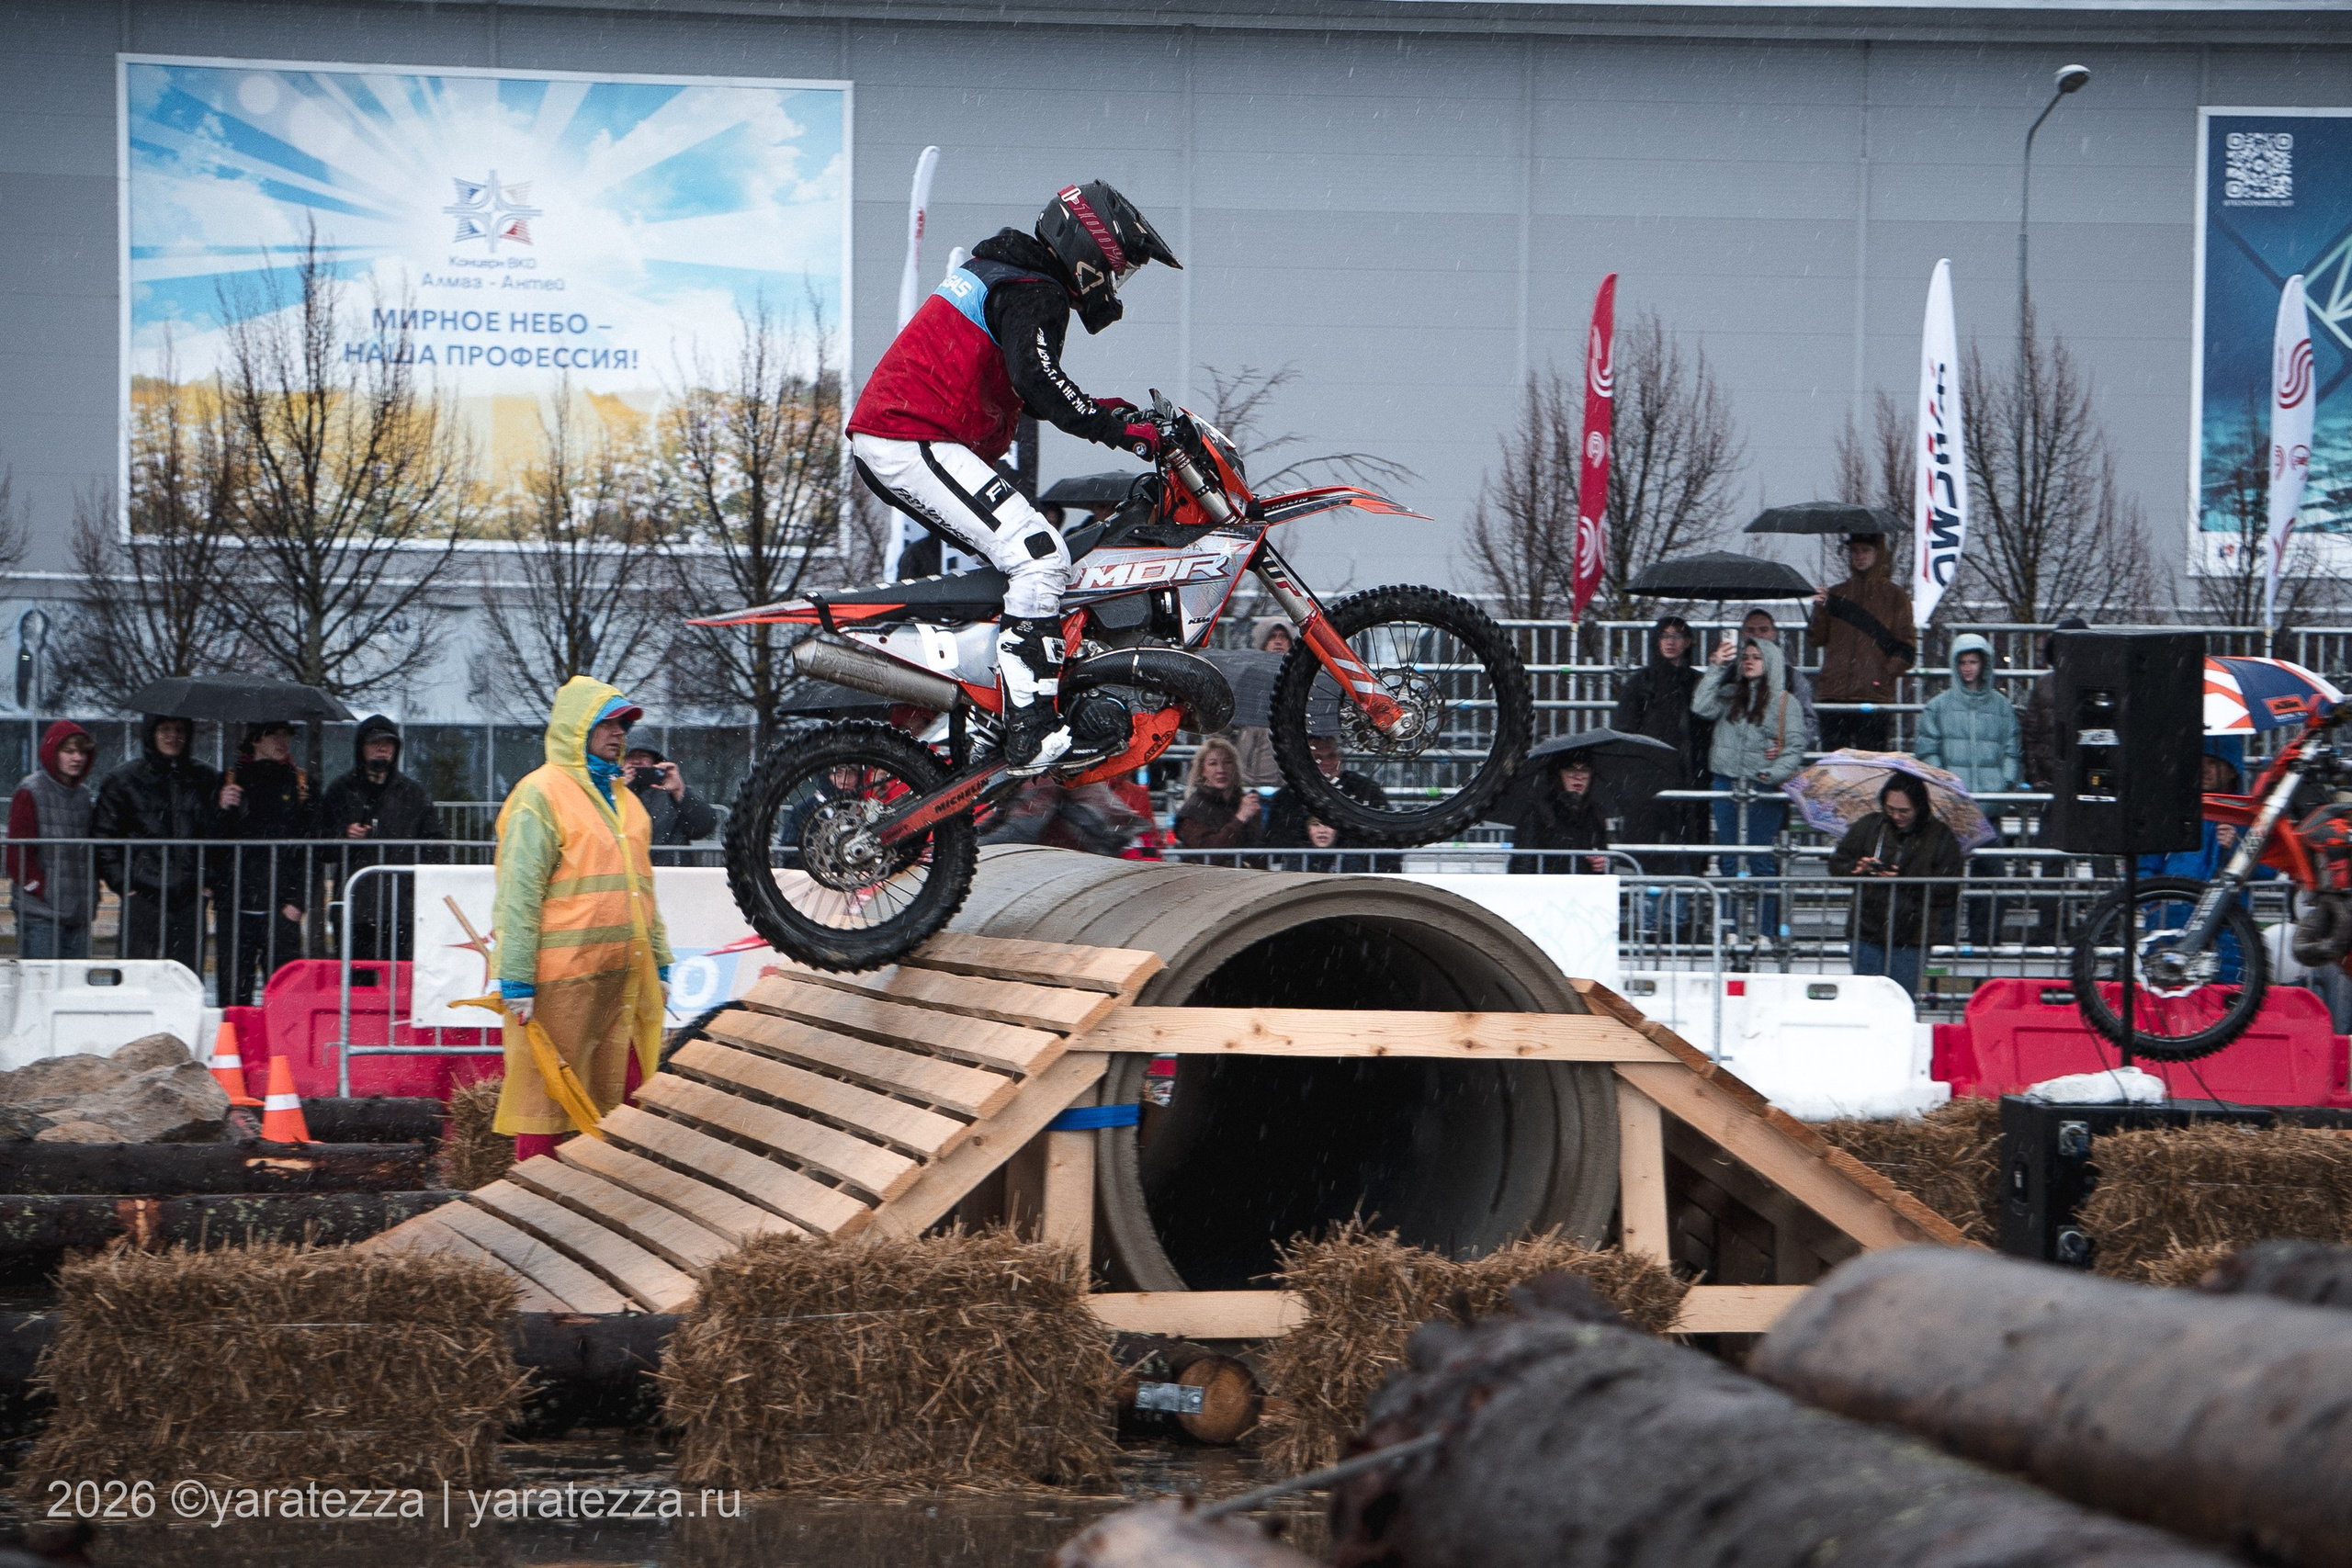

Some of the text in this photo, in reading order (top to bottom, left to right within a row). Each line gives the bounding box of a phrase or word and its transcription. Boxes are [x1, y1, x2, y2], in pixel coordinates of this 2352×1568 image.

[420, 274, 482, 288] Алмаз
[501, 276, 565, 291] Антей
[372, 308, 501, 332] МИРНОЕ
[509, 312, 588, 333] НЕБО
[344, 342, 639, 369] НАША ПРОФЕССИЯ!
[1187, 615, 1211, 626] KTM
[934, 777, 990, 814] MICHELIN
